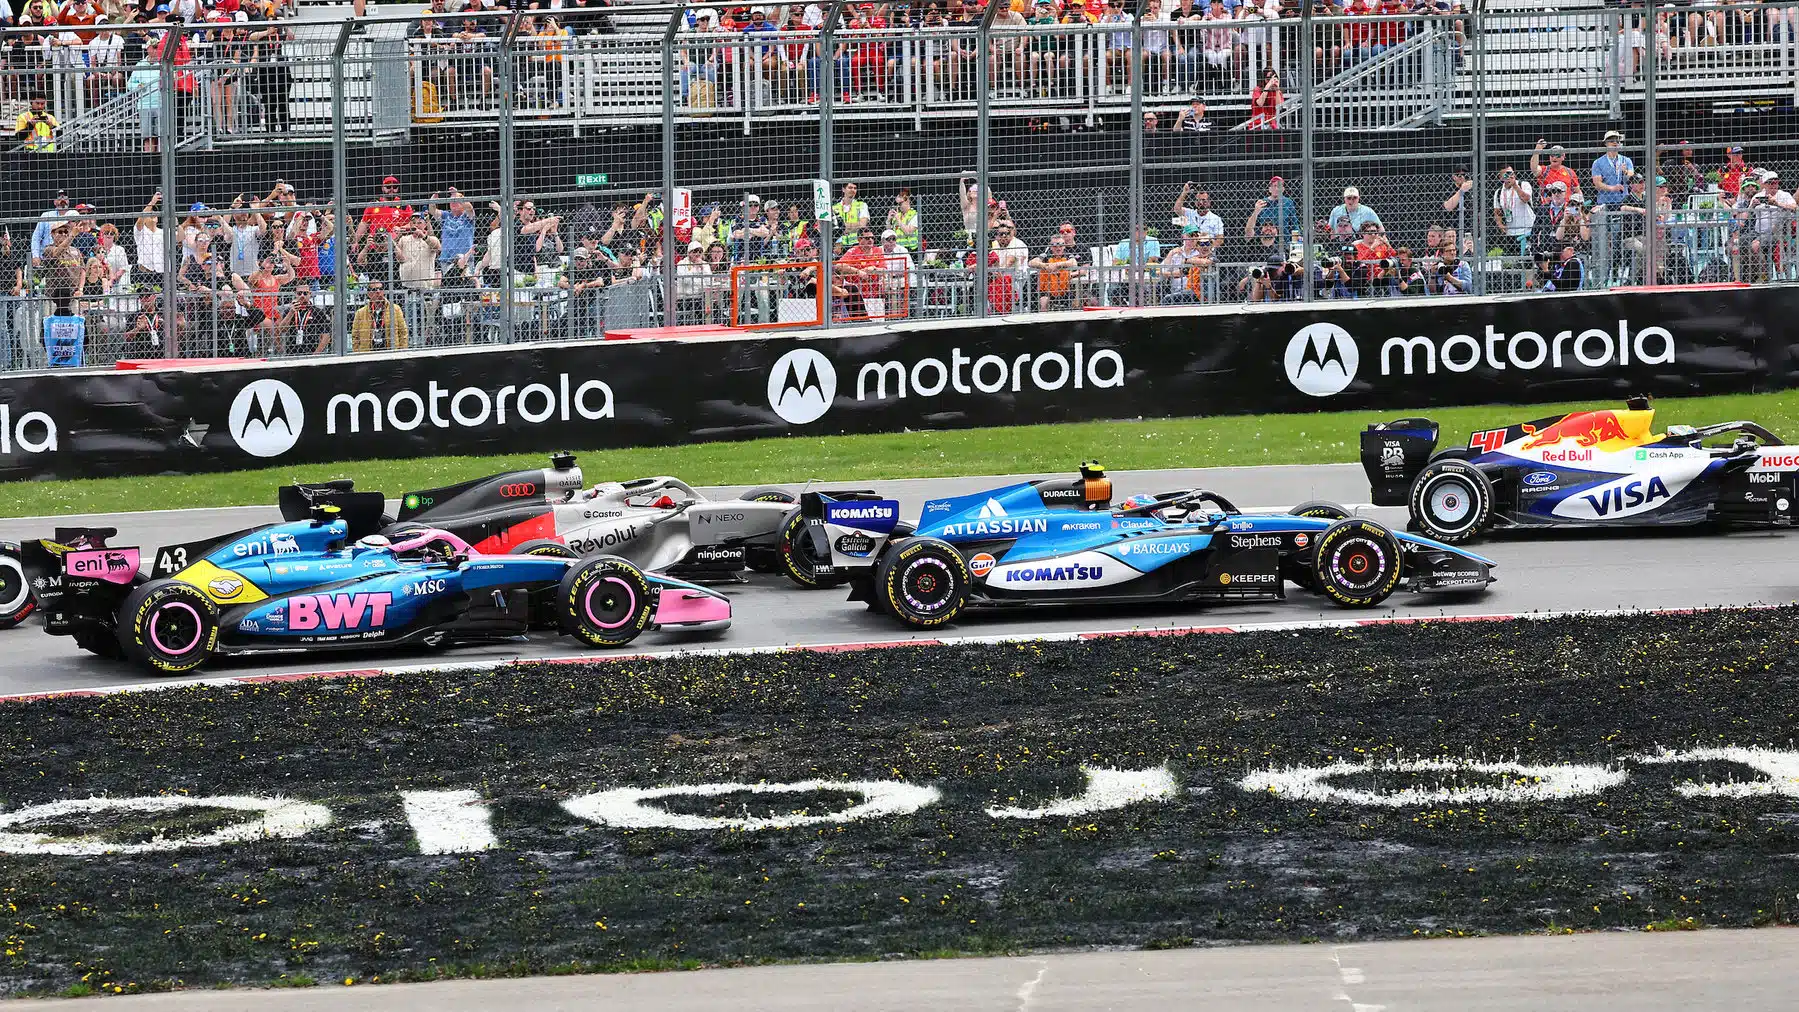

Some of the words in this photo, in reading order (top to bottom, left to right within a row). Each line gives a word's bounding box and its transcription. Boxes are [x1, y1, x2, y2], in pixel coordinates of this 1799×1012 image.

[586, 175, 606, 183] Exit
[816, 201, 829, 211] EXIT
[673, 208, 690, 217] FIRE
[1380, 319, 1676, 376] motorola
[856, 342, 1125, 401] motorola
[326, 372, 615, 434] motorola
[1470, 428, 1507, 454] 41
[1542, 450, 1565, 461] Red
[1568, 450, 1592, 461] Bull
[1649, 451, 1668, 459] Cash
[1669, 451, 1684, 460] App
[1442, 465, 1465, 473] PIRELLI
[1529, 473, 1552, 484] Ford
[1749, 472, 1781, 483] Mobil
[1043, 490, 1081, 498] DURACELL
[1521, 485, 1560, 493] RACING
[421, 496, 434, 506] bp
[1579, 476, 1671, 517] VISA
[592, 510, 623, 519] Castrol
[715, 513, 745, 522] NEXO
[831, 505, 893, 519] KOMATSU
[943, 518, 1048, 536] ATLASSIAN
[1070, 522, 1101, 530] Kraken
[1121, 519, 1154, 529] Claude
[1361, 523, 1386, 538] PIRELLI
[569, 524, 639, 555] Revolut
[841, 536, 870, 544] Estrella
[1231, 534, 1282, 549] Stephens
[233, 536, 267, 556] eni
[841, 543, 867, 551] Galicia
[1133, 542, 1190, 555] BARCLAYS
[698, 550, 742, 561] ninjaOne
[899, 544, 922, 560] PIRELLI
[75, 555, 102, 572] eni
[159, 547, 187, 574] 43
[970, 559, 994, 569] Gulf
[1006, 563, 1103, 581] KOMATSU
[1232, 574, 1276, 583] KEEPER
[413, 579, 446, 596] MSC
[569, 569, 590, 604] ZERO
[134, 597, 152, 633] ZERO
[288, 591, 393, 631] BWT
[240, 619, 259, 628] ADA
[363, 630, 385, 638] Delphi
